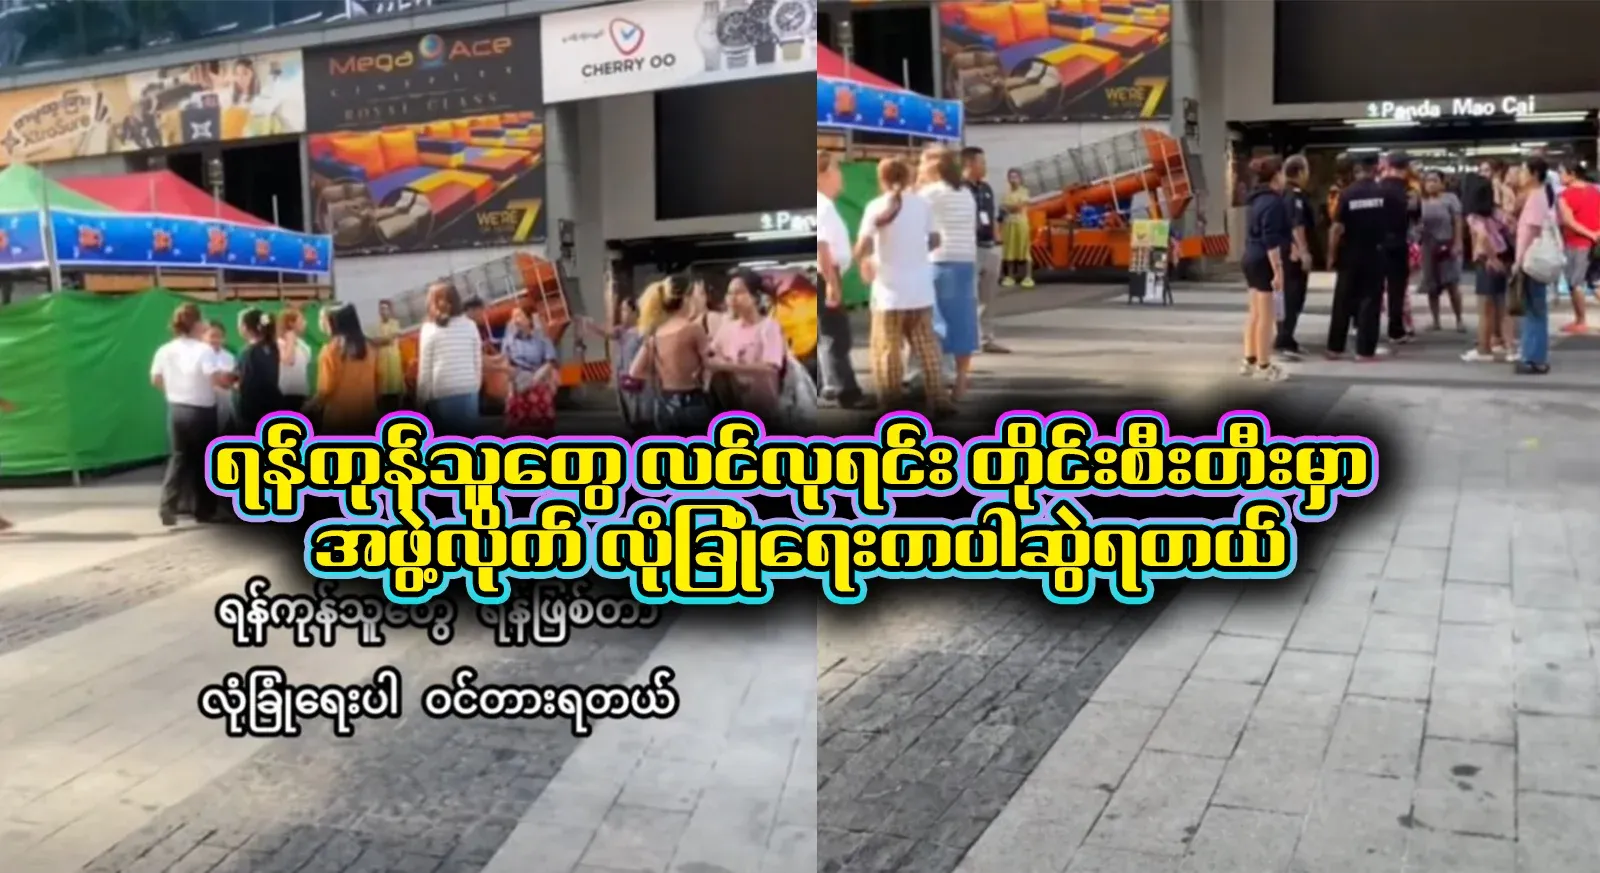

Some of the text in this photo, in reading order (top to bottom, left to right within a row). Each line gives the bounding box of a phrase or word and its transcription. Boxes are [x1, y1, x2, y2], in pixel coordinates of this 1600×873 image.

[329, 37, 512, 76] Mega Ace
[581, 52, 677, 77] CHERRY OO
[1452, 98, 1495, 116] Mao
[1502, 95, 1536, 116] Cai
